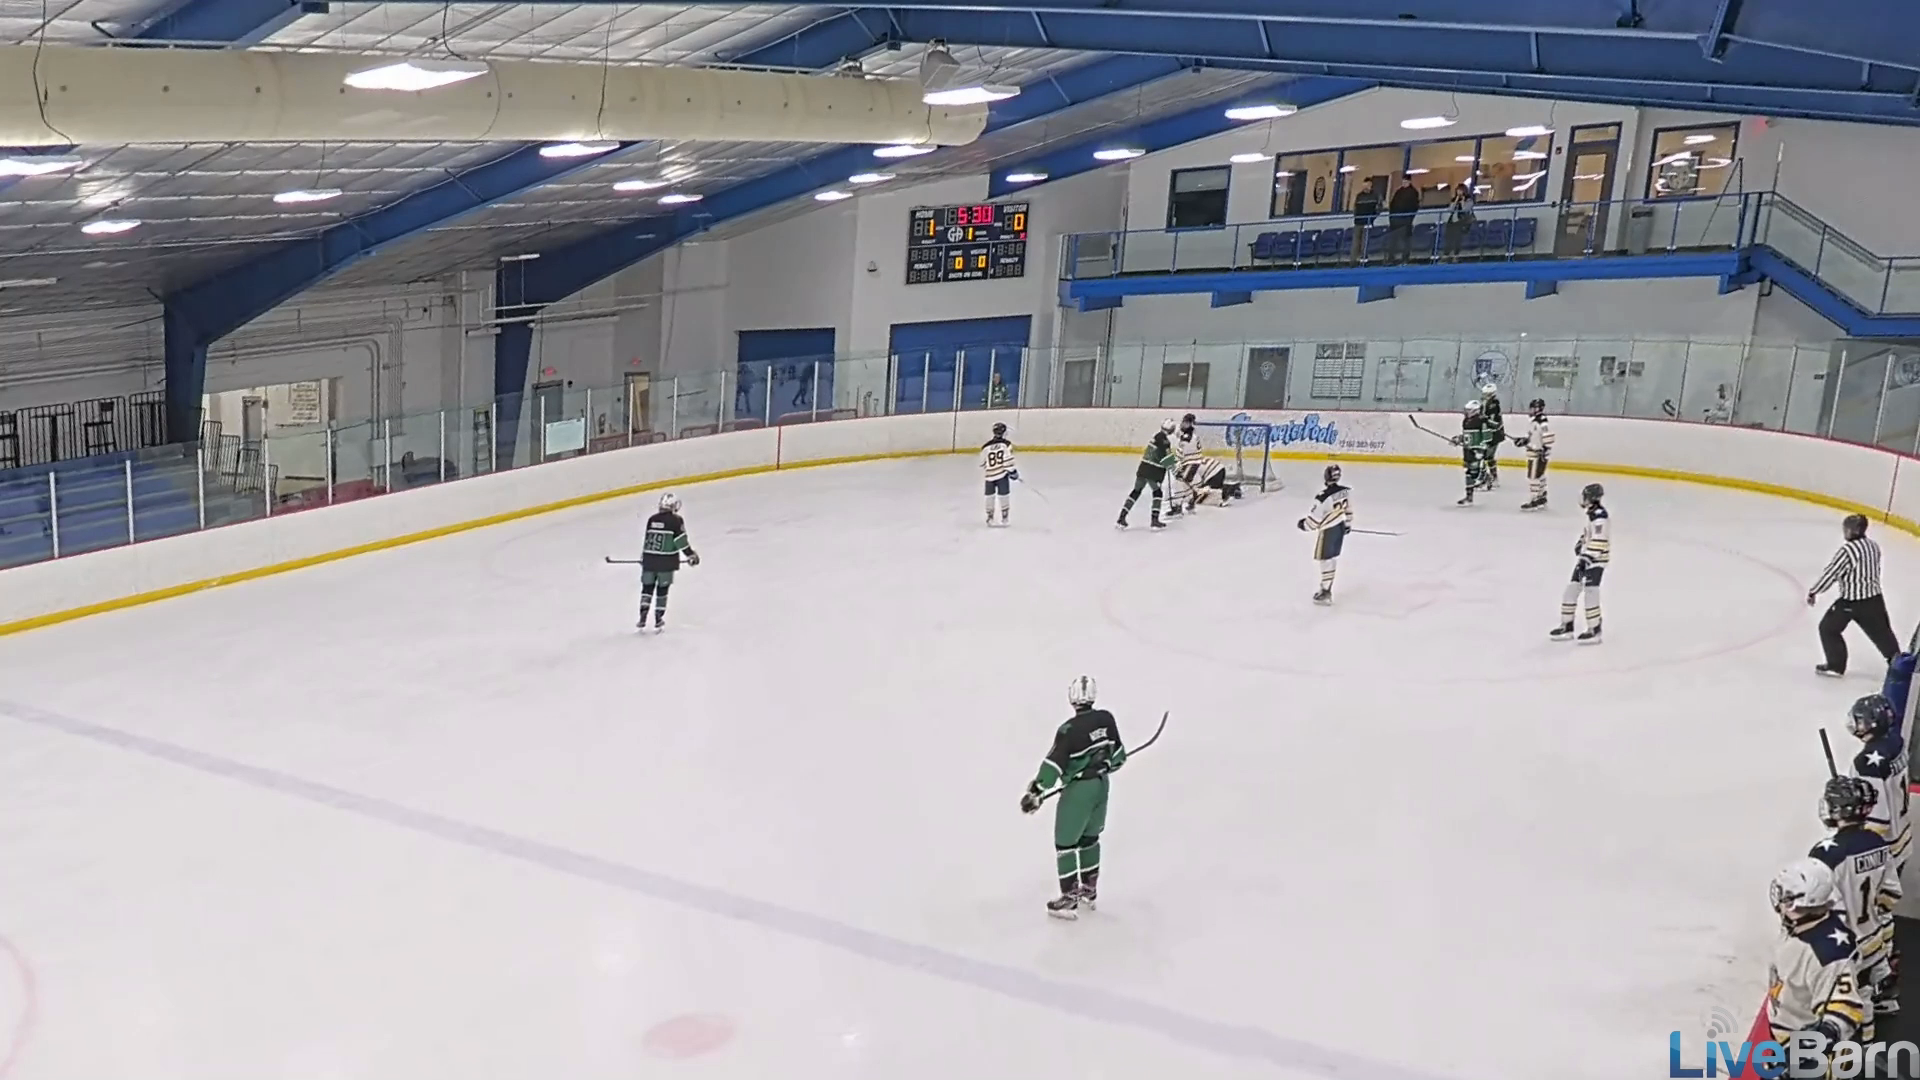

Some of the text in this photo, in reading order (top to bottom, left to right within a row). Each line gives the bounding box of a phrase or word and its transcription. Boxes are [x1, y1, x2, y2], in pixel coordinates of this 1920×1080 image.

[957, 206, 993, 224] 5:30
[1013, 213, 1025, 231] 0
[929, 218, 935, 237] 1
[968, 227, 974, 241] 1
[955, 256, 964, 270] 0
[978, 255, 987, 269] 0
[988, 450, 1005, 467] 89
[1857, 876, 1871, 925] 1
